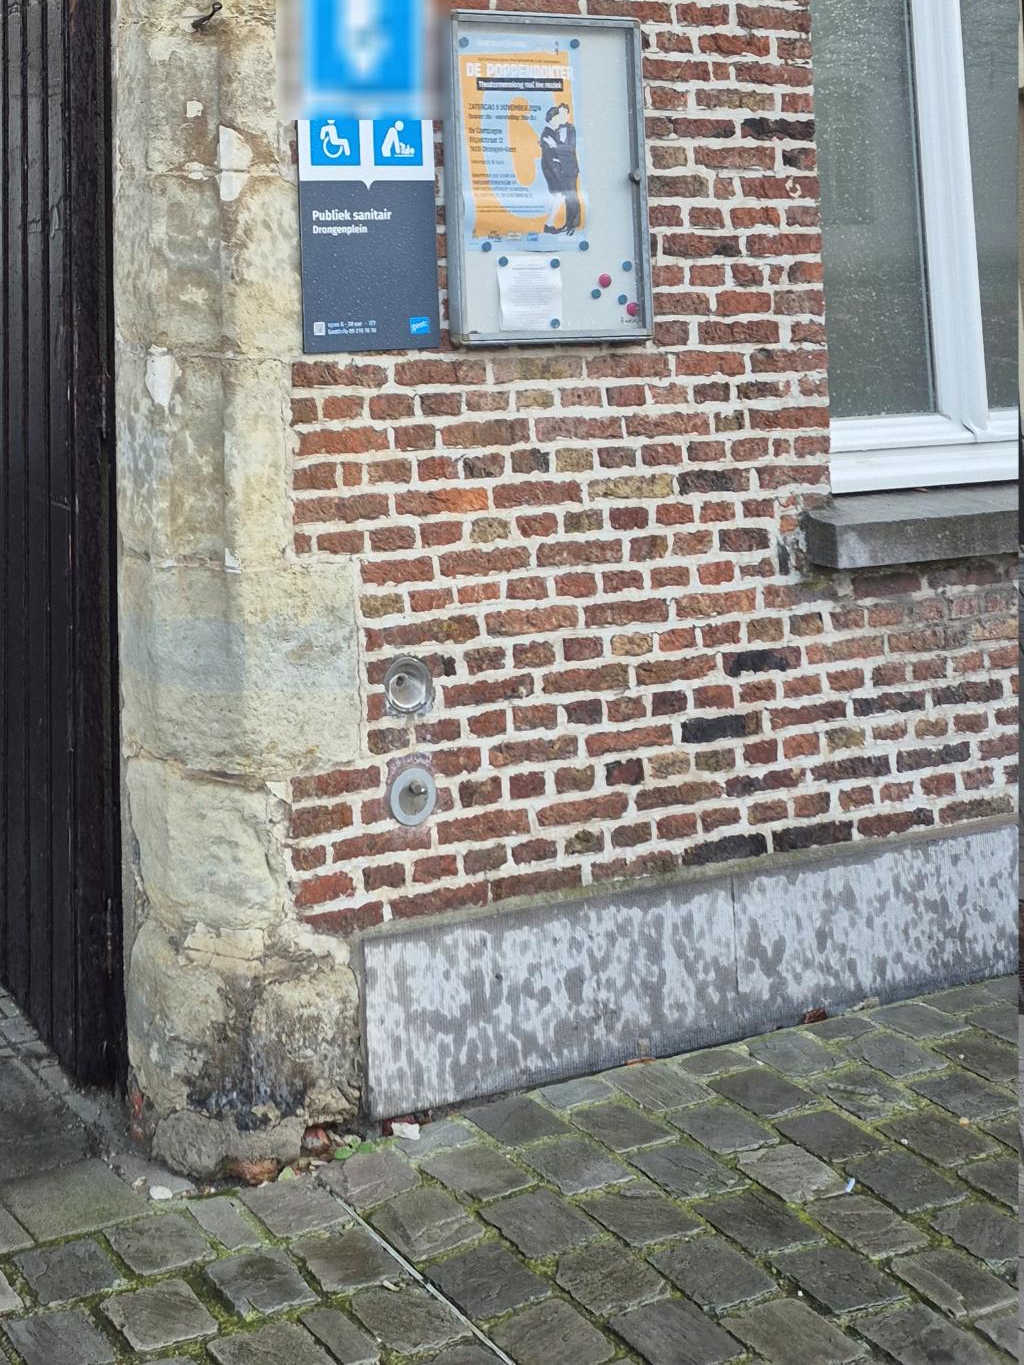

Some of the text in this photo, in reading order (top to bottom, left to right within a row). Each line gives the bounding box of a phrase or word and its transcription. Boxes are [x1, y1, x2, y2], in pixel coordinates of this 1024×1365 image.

[466, 62, 481, 77] DE
[312, 209, 392, 221] Publiek sanitair
[312, 224, 368, 236] Drongenplein
